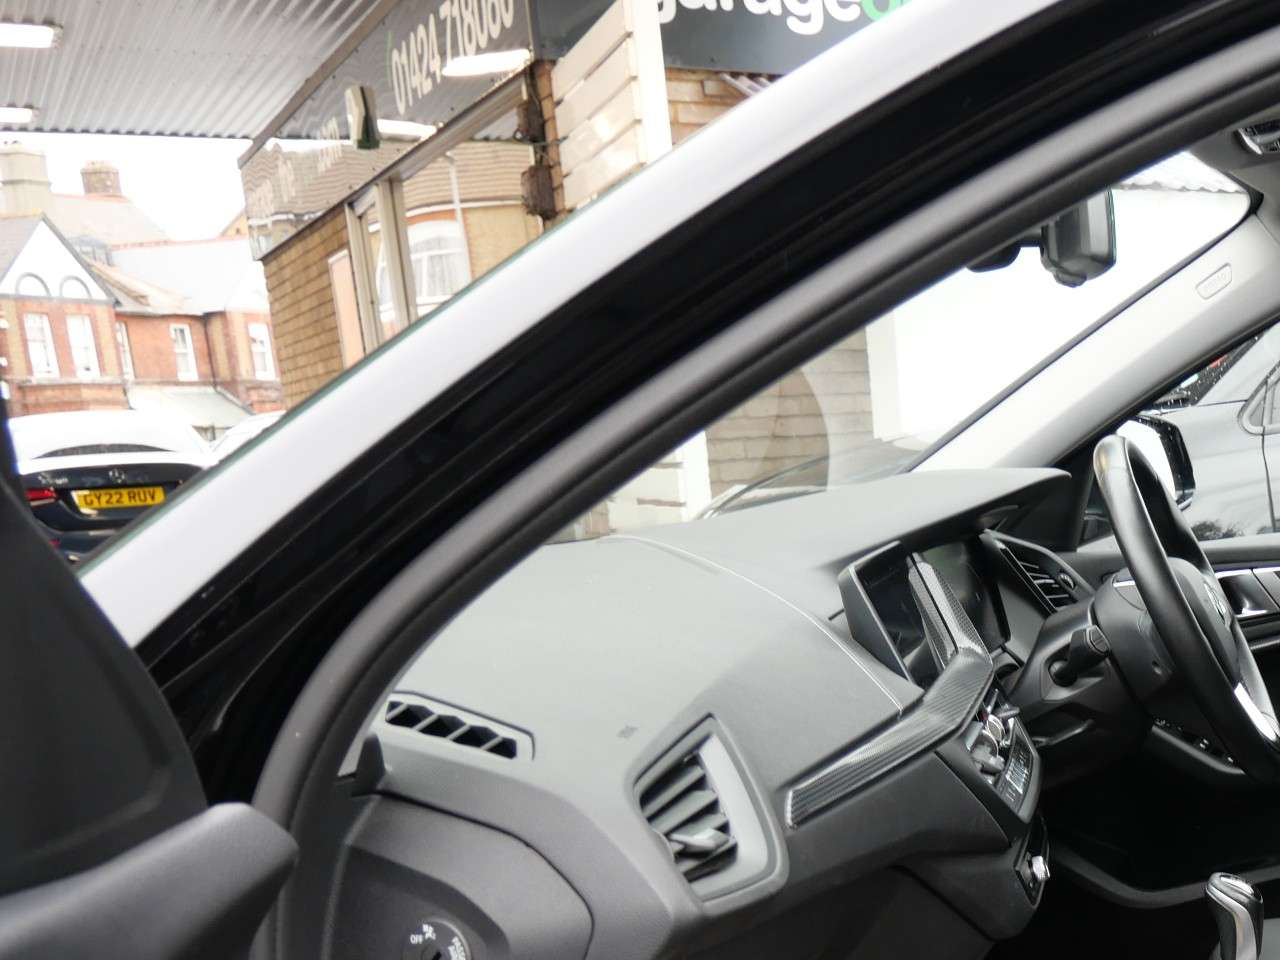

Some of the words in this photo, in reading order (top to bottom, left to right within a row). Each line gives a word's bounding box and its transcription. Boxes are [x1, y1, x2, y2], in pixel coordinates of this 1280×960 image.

[392, 13, 441, 115] 01424
[83, 491, 124, 506] GY22
[127, 488, 156, 503] RUV
